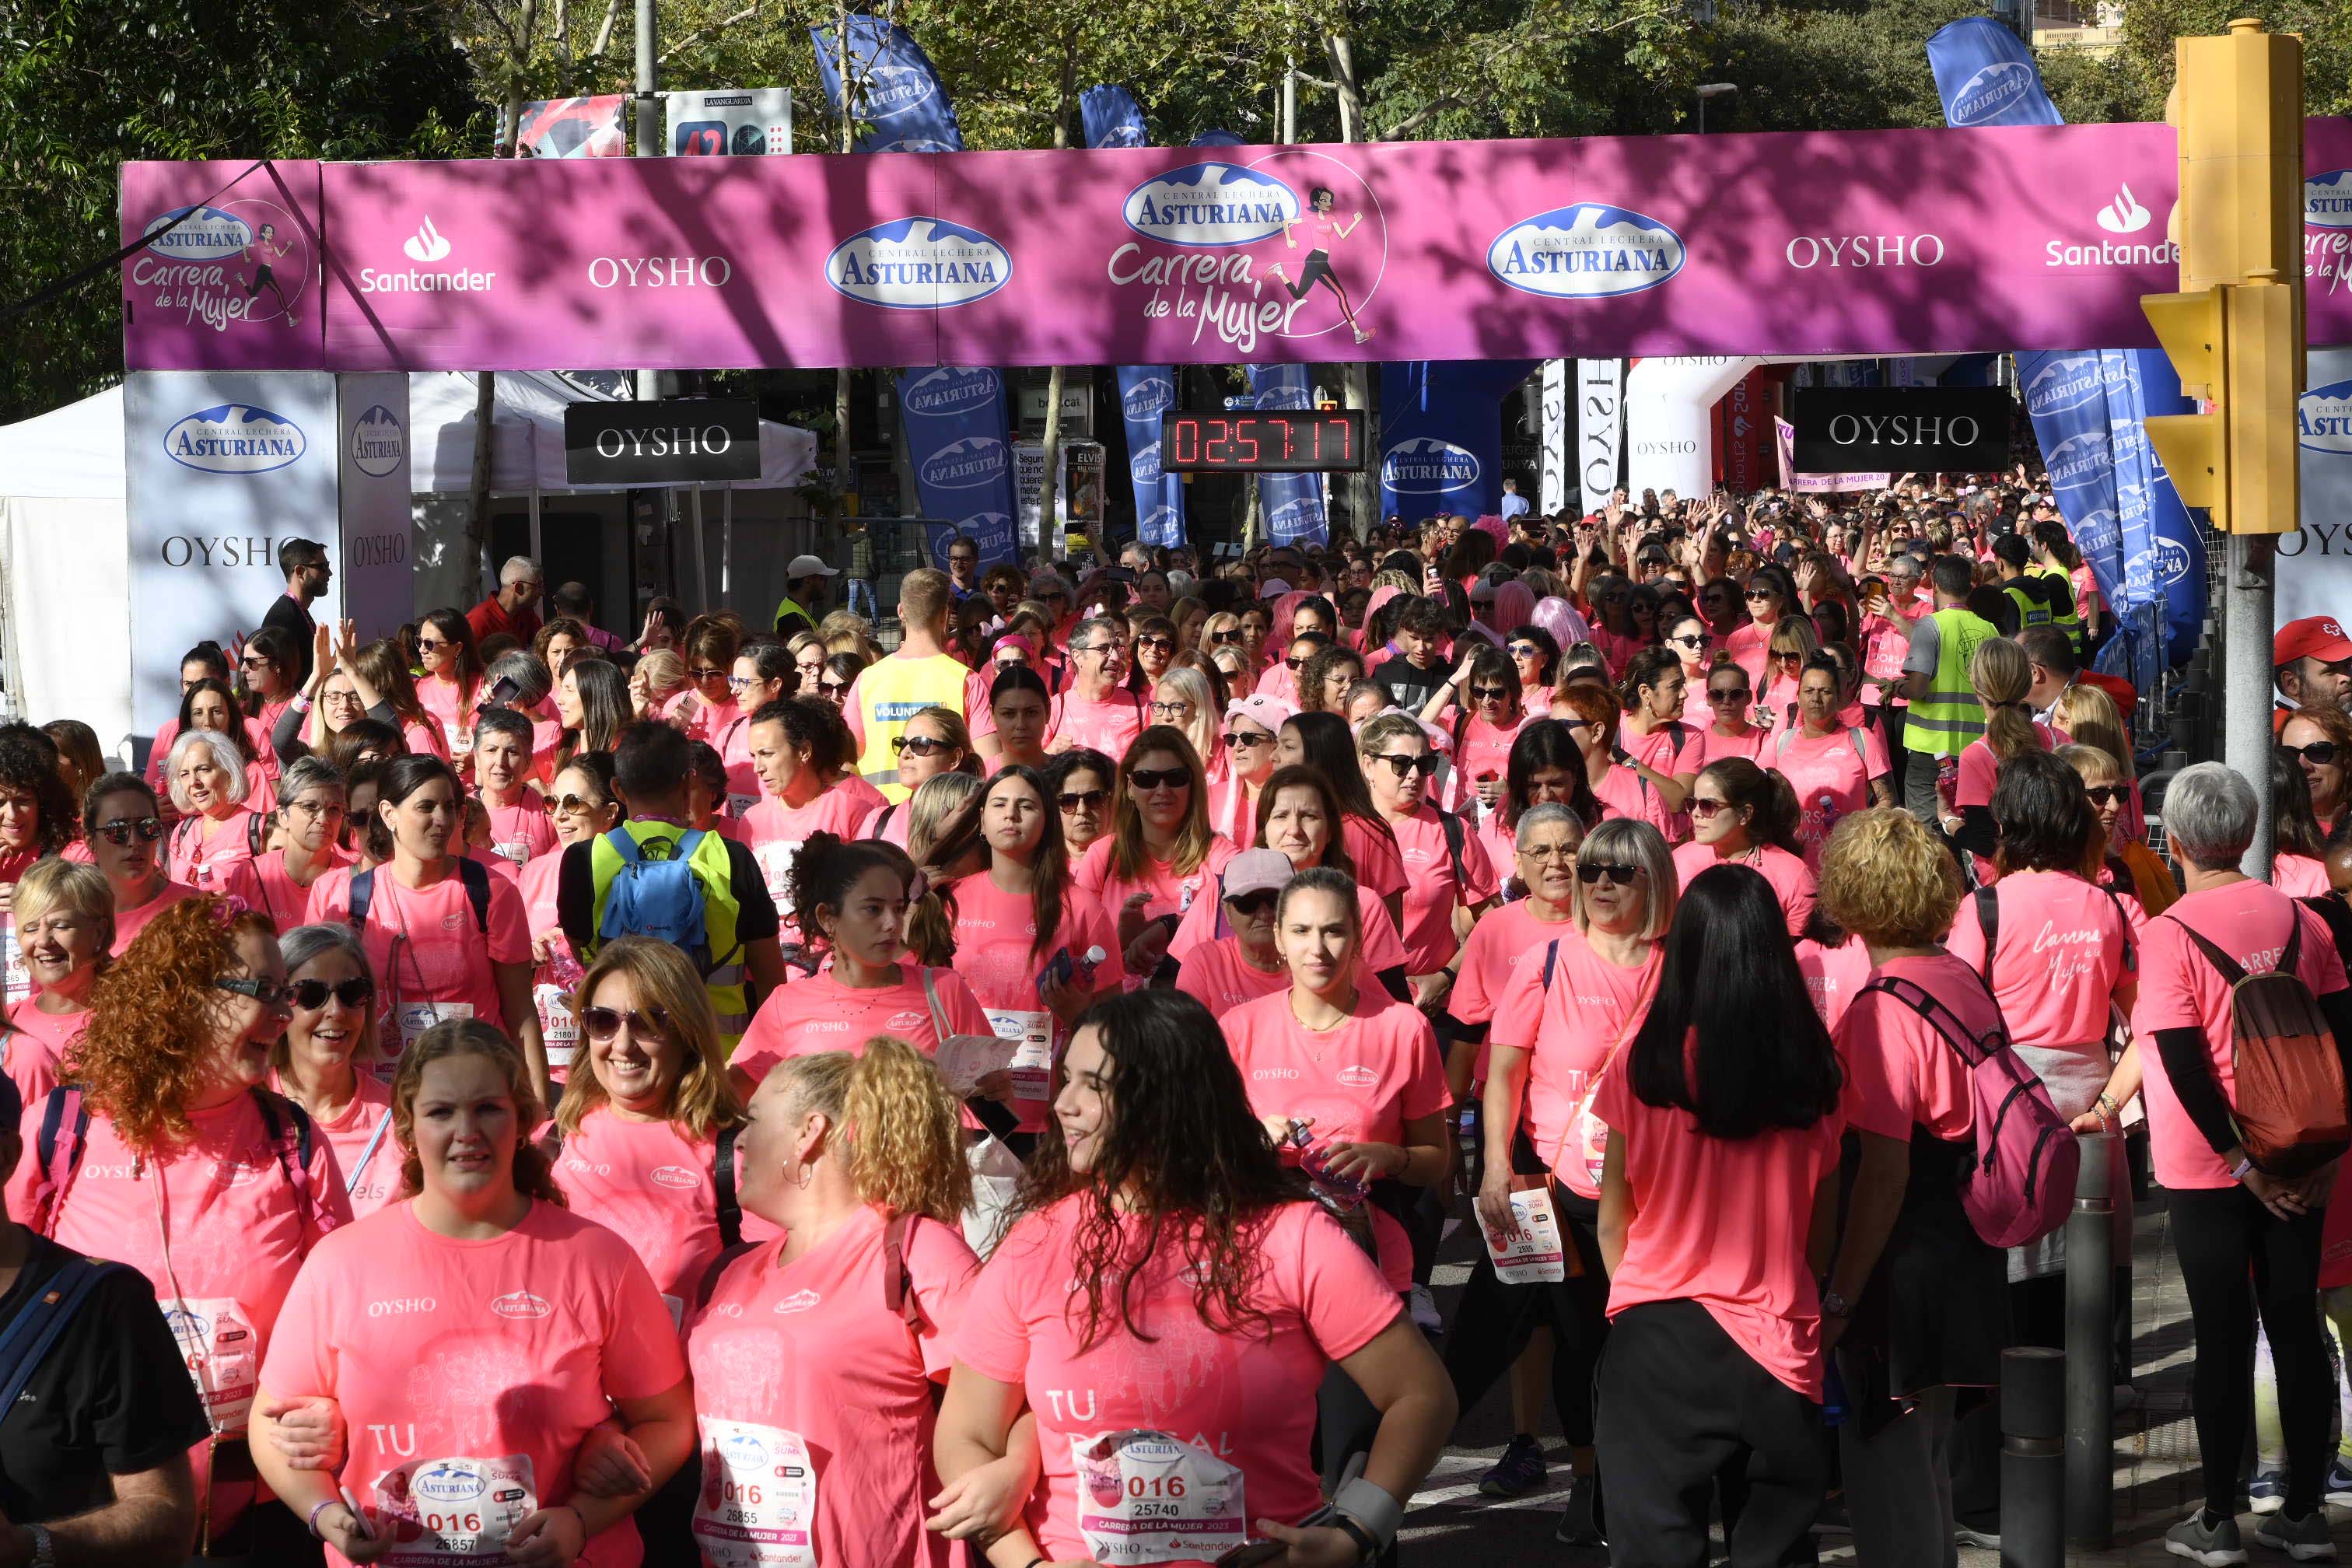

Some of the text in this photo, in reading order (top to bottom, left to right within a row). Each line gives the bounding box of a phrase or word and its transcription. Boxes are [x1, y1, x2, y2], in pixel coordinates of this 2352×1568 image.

[1164, 191, 1220, 201] CENTRAL
[1136, 193, 1286, 226] ASTURIANA
[1533, 234, 1664, 247] CENTRAL LECHERA
[1786, 234, 1944, 268] OYSHO
[868, 249, 925, 257] CENTRAL
[1108, 243, 1251, 285] Carrera
[1502, 240, 1671, 275] ASTURIANA
[133, 258, 224, 286] Carrera
[588, 256, 732, 289] OYSHO
[839, 251, 997, 285] ASTURIANA
[360, 267, 495, 292] Santander
[156, 283, 258, 332] de la Mujer
[1143, 282, 1308, 353] de la Mujer
[595, 425, 732, 457] OYSHO
[1175, 419, 1351, 463] 02:57:17
[1829, 414, 1979, 446] OYSHO
[175, 430, 296, 457] ASTURIANA
[355, 432, 401, 460] ASTURIANA
[1637, 440, 1696, 455] OYSHO
[1077, 453, 1101, 463] ELVIS
[1020, 467, 1031, 475] que
[1384, 460, 1473, 482] ASTURIANA
[353, 531, 405, 569] OYSHO
[1253, 1066, 1300, 1081] OYSHO
[368, 1297, 436, 1318] OYSHO
[1046, 1388, 1097, 1422] TU
[367, 1423, 416, 1457] TU
[420, 1480, 481, 1494] ASTURIANA
[723, 1481, 762, 1504] 016
[1128, 1476, 1185, 1498] 016
[726, 1508, 758, 1524] 26855
[1134, 1503, 1179, 1517] 25740
[427, 1512, 481, 1532] 016
[1098, 1521, 1138, 1531] CARRERA
[1141, 1521, 1153, 1530] DE
[1155, 1521, 1167, 1531] LA
[1171, 1521, 1203, 1531] MUJER
[434, 1537, 476, 1552] 26857
[749, 1531, 777, 1542] MUJER
[1182, 1538, 1234, 1552] Santander
[758, 1550, 802, 1564] Santander
